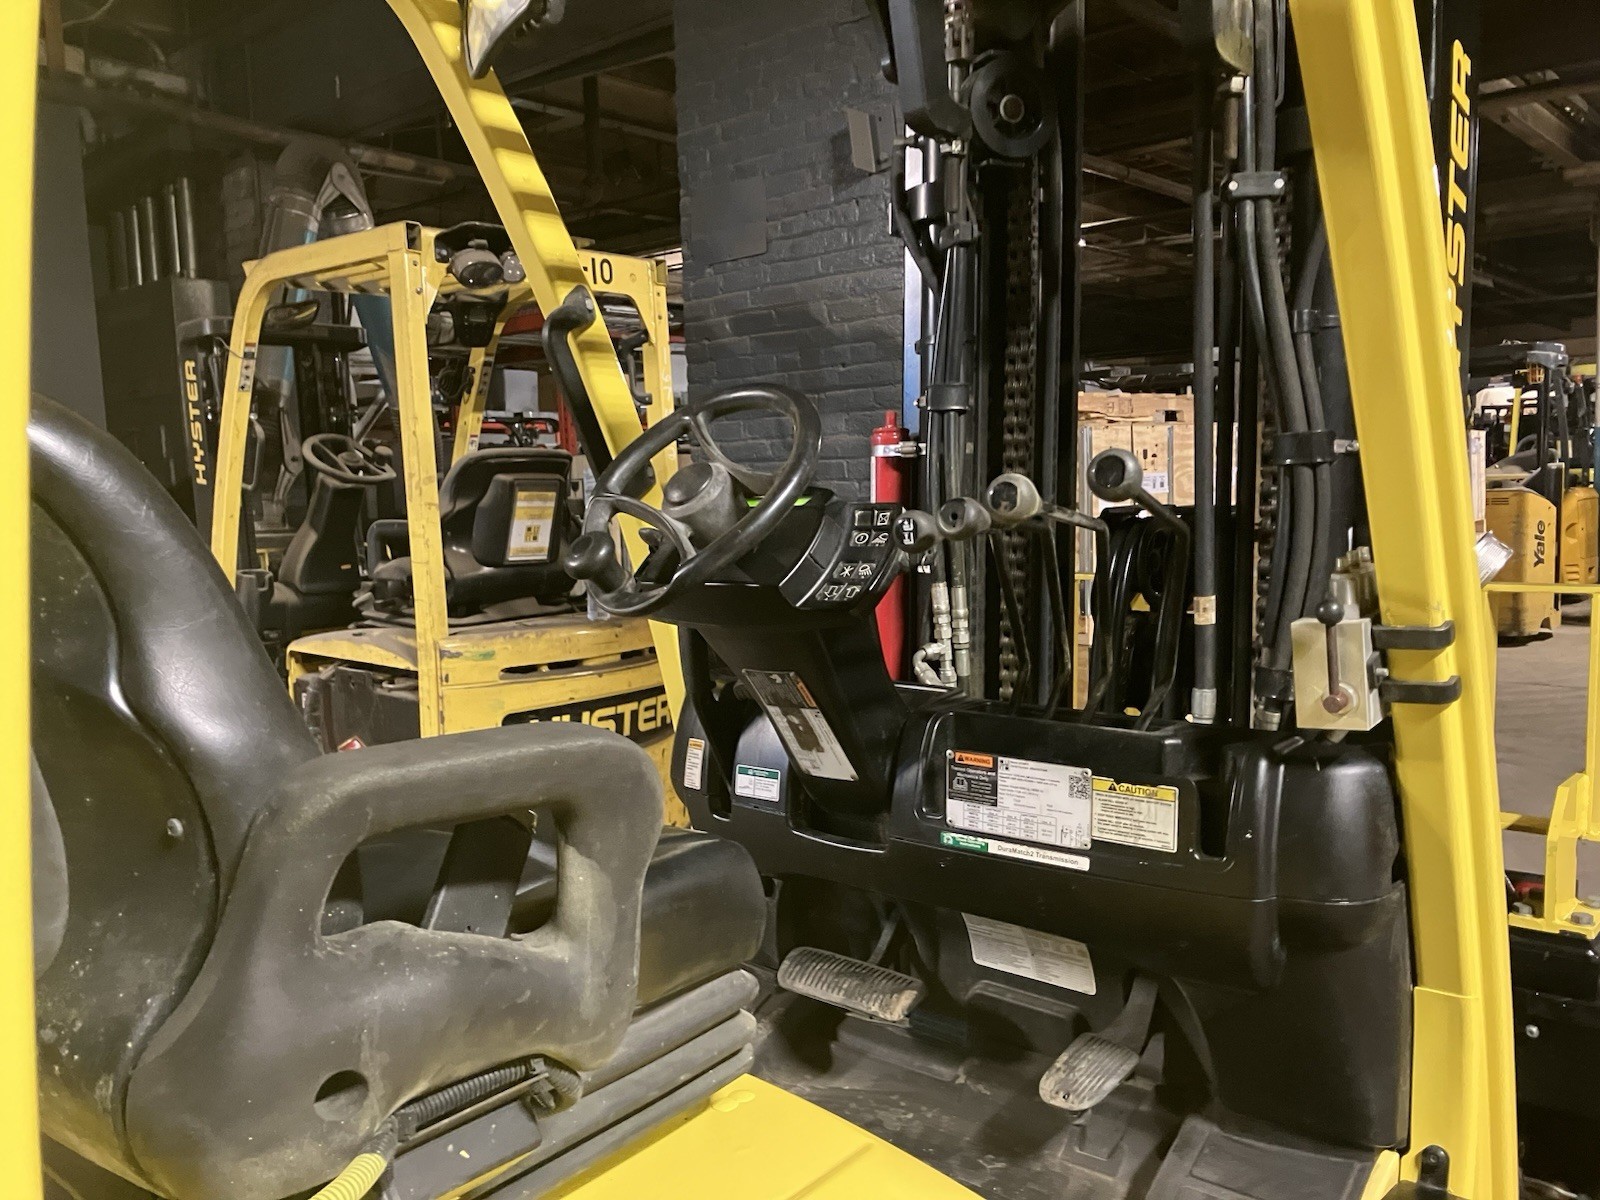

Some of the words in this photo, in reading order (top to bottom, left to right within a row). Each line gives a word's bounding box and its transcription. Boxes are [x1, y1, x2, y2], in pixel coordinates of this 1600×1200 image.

[1446, 39, 1471, 366] STER
[184, 359, 208, 486] HYSTER
[1533, 520, 1546, 568] Yale
[529, 693, 672, 737] STER
[964, 756, 991, 765] WARNING
[1118, 784, 1158, 797] CAUTION
[997, 844, 1034, 857] DuraMatch2
[1036, 851, 1079, 865] Transmission
